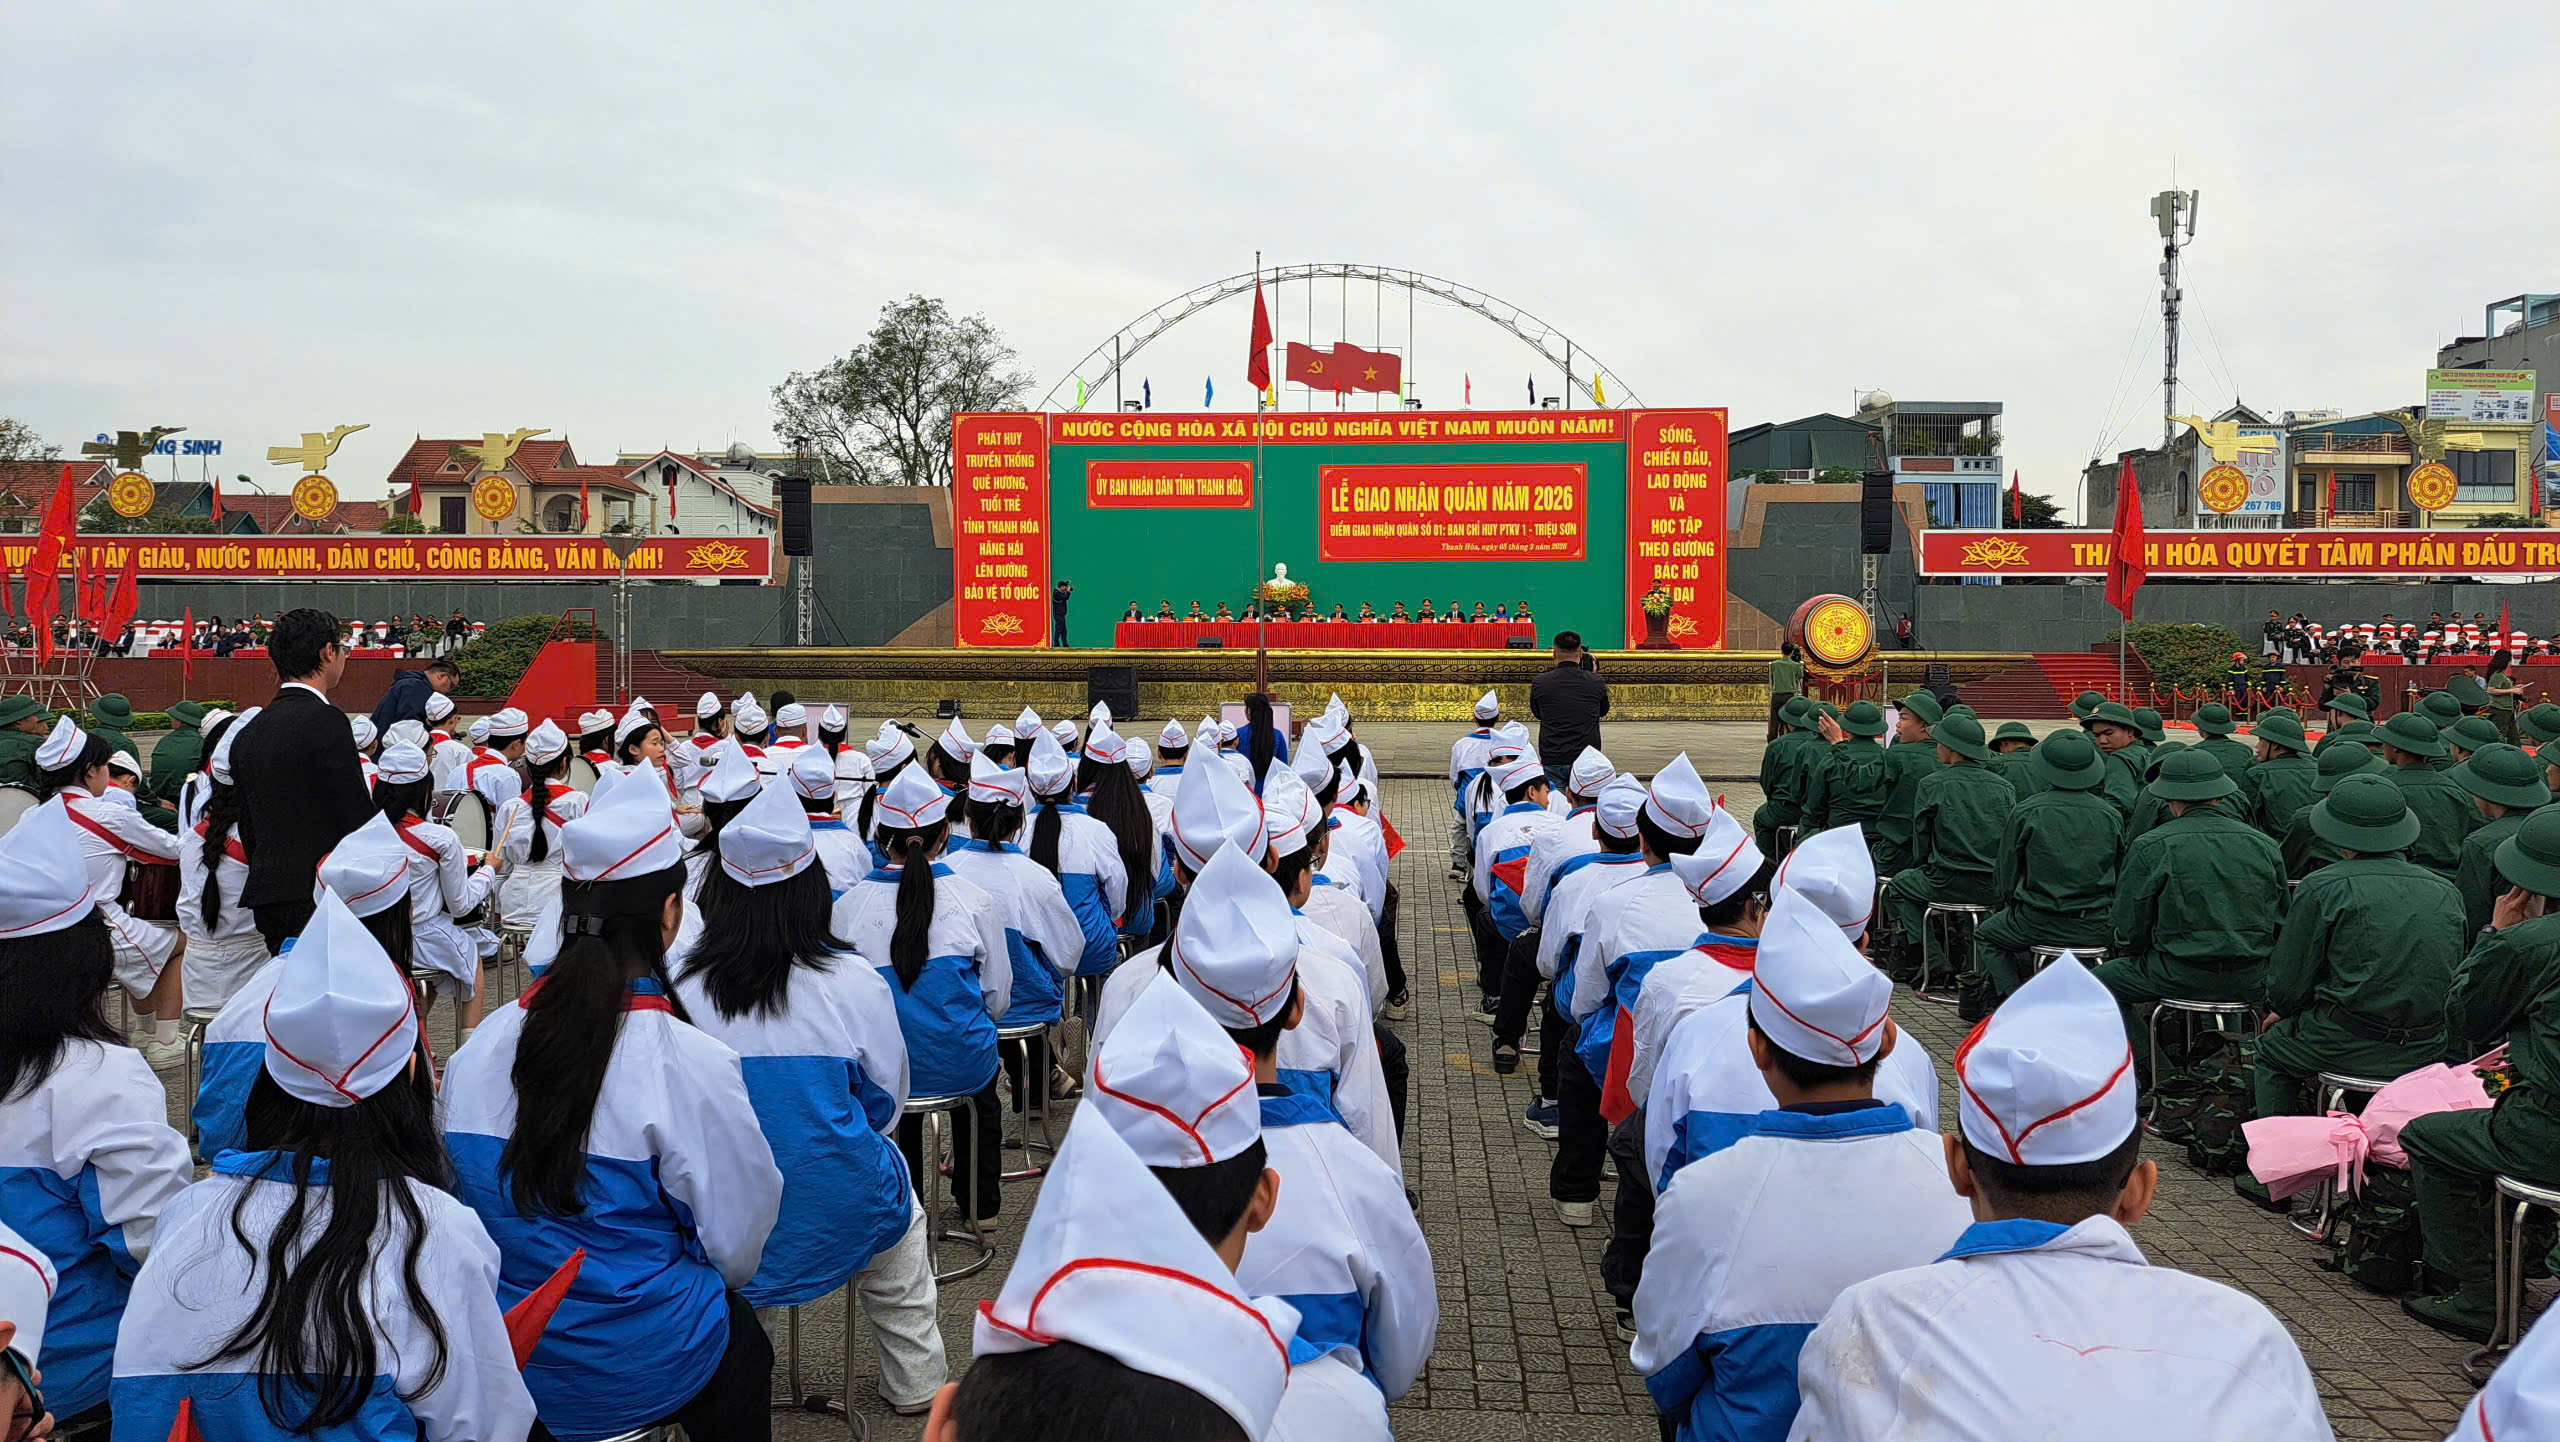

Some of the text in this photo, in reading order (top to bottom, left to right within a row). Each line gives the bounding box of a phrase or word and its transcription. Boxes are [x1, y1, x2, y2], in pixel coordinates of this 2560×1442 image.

[1062, 419, 1115, 437] NƯỚC
[1120, 419, 1172, 440] CỘNG
[1177, 418, 1216, 437] HÒA
[1221, 419, 1247, 437] XÃ
[1289, 417, 1328, 437] CHỦ
[1333, 418, 1393, 436] NGHĨA
[1399, 418, 1439, 439] VIỆT
[1445, 420, 1490, 436] NAM
[1496, 417, 1555, 435] MUÔN
[1560, 416, 1615, 434] NĂM!
[1659, 423, 1696, 445] SỐNG,
[977, 429, 1022, 446] PHÁT HUY
[182, 439, 221, 455] SINH
[1643, 445, 1711, 467] CHIẾN ĐẤU,
[1004, 450, 1034, 468] THỐNG
[973, 474, 1028, 491] QUÊ HƯƠNG,
[1096, 473, 1244, 496] ỦY BAN NHÂN DÂN TỈNH THANH HÓA
[1648, 470, 1707, 492] LAO ĐỘNG
[981, 493, 1021, 512] TUỔI TRẺ
[1331, 478, 1573, 517] LỄ GIAO NHẬN QUÂN NĂM 2026
[1669, 493, 1685, 511] VÀ
[2245, 501, 2261, 510] 267
[2263, 501, 2282, 510] 789
[963, 516, 1039, 534] TỈNH THANH HÓA
[1330, 520, 1351, 536] ĐIỂM
[1352, 524, 1371, 536] GIAO
[1373, 521, 1395, 539] NHẬN
[1397, 521, 1418, 537] QUÂN
[1420, 520, 1432, 536] SỐ
[1433, 524, 1446, 536] 01:
[1447, 524, 1465, 536] BAN
[1482, 523, 1498, 536] HUY
[1500, 523, 1520, 536] PTKV
[1522, 523, 1527, 536] 1
[1534, 521, 1557, 539] TRIỆU
[1560, 522, 1577, 536] SƠN
[1651, 516, 1702, 538] HỌC TẬP
[979, 540, 1024, 556] HĂNG HÁI
[1441, 543, 1463, 551] Thanh
[1482, 543, 1498, 552] ngày
[1509, 542, 1528, 552] tháng
[1639, 540, 1714, 557] THEO GƯƠNG
[2071, 543, 2159, 566] THH
[2166, 537, 2219, 566] HÓA
[2226, 534, 2309, 568] QUYẾT
[2318, 537, 2373, 566] TÂM
[2380, 533, 2455, 566] PHẤN
[2462, 533, 2516, 566] ĐẤU
[138, 542, 190, 571] GIÀU,
[196, 543, 250, 569] NƯỚC
[257, 547, 322, 575] MẠNH,
[327, 542, 369, 569] DÂN
[375, 539, 421, 572] CHỦ,
[426, 542, 481, 569] CÔNG
[488, 539, 549, 572] BẰNG,
[555, 542, 596, 569] VĂN
[602, 547, 664, 569] MNH!
[976, 561, 1028, 578] LÊN ĐƯỜNG
[1654, 561, 1678, 579] BÁC
[965, 581, 1039, 603] BẢO VỆ TỔ QUỐC
[1673, 587, 1694, 605] ĐẠI
